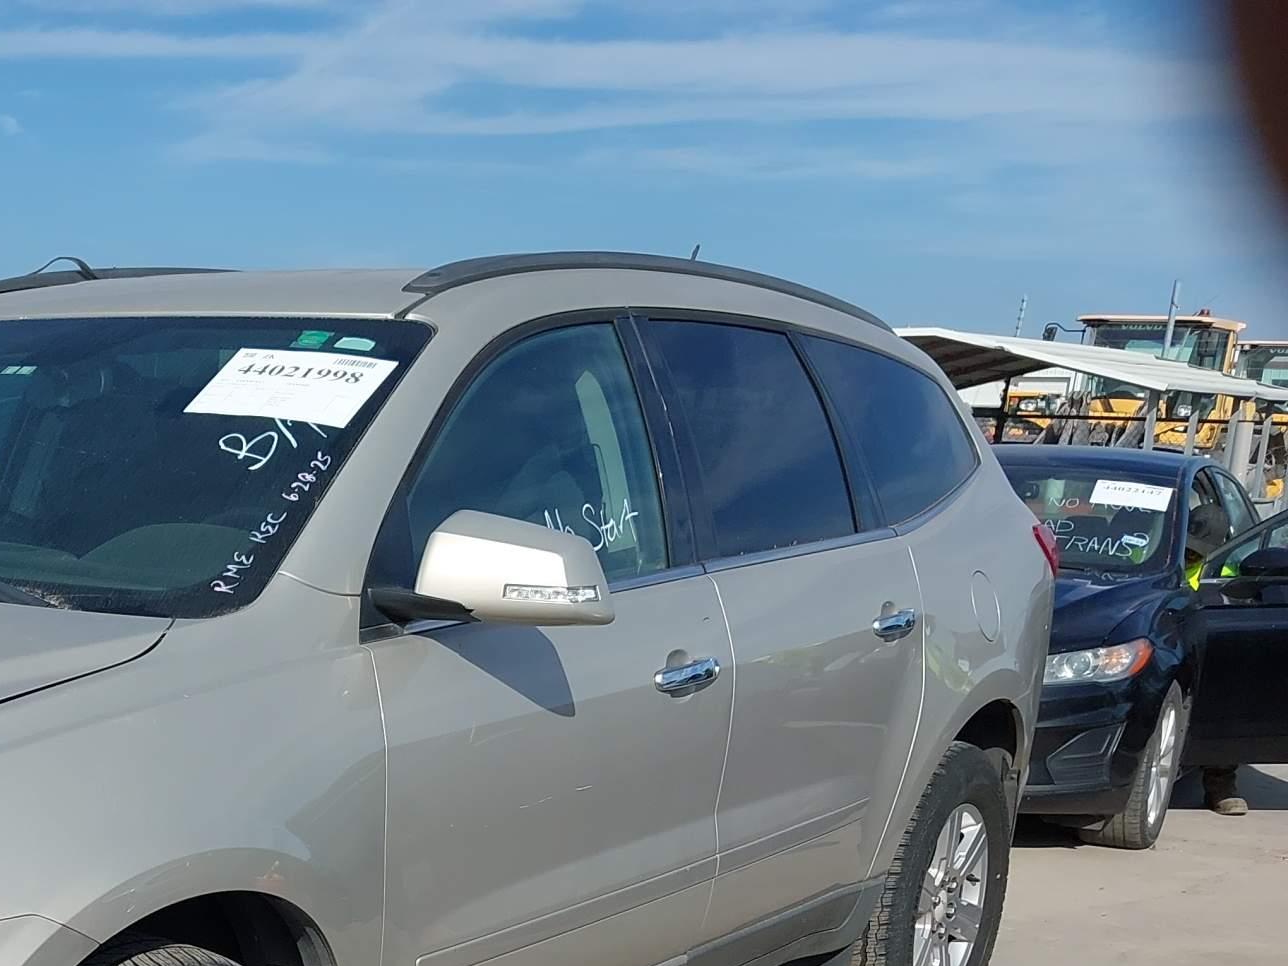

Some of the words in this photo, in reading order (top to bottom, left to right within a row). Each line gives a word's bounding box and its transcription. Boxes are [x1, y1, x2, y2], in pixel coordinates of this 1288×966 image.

[238, 363, 365, 385] 44021998
[282, 451, 331, 501] 6-28-25
[1048, 497, 1079, 508] NO
[582, 498, 639, 551] Start
[1044, 519, 1074, 532] AD
